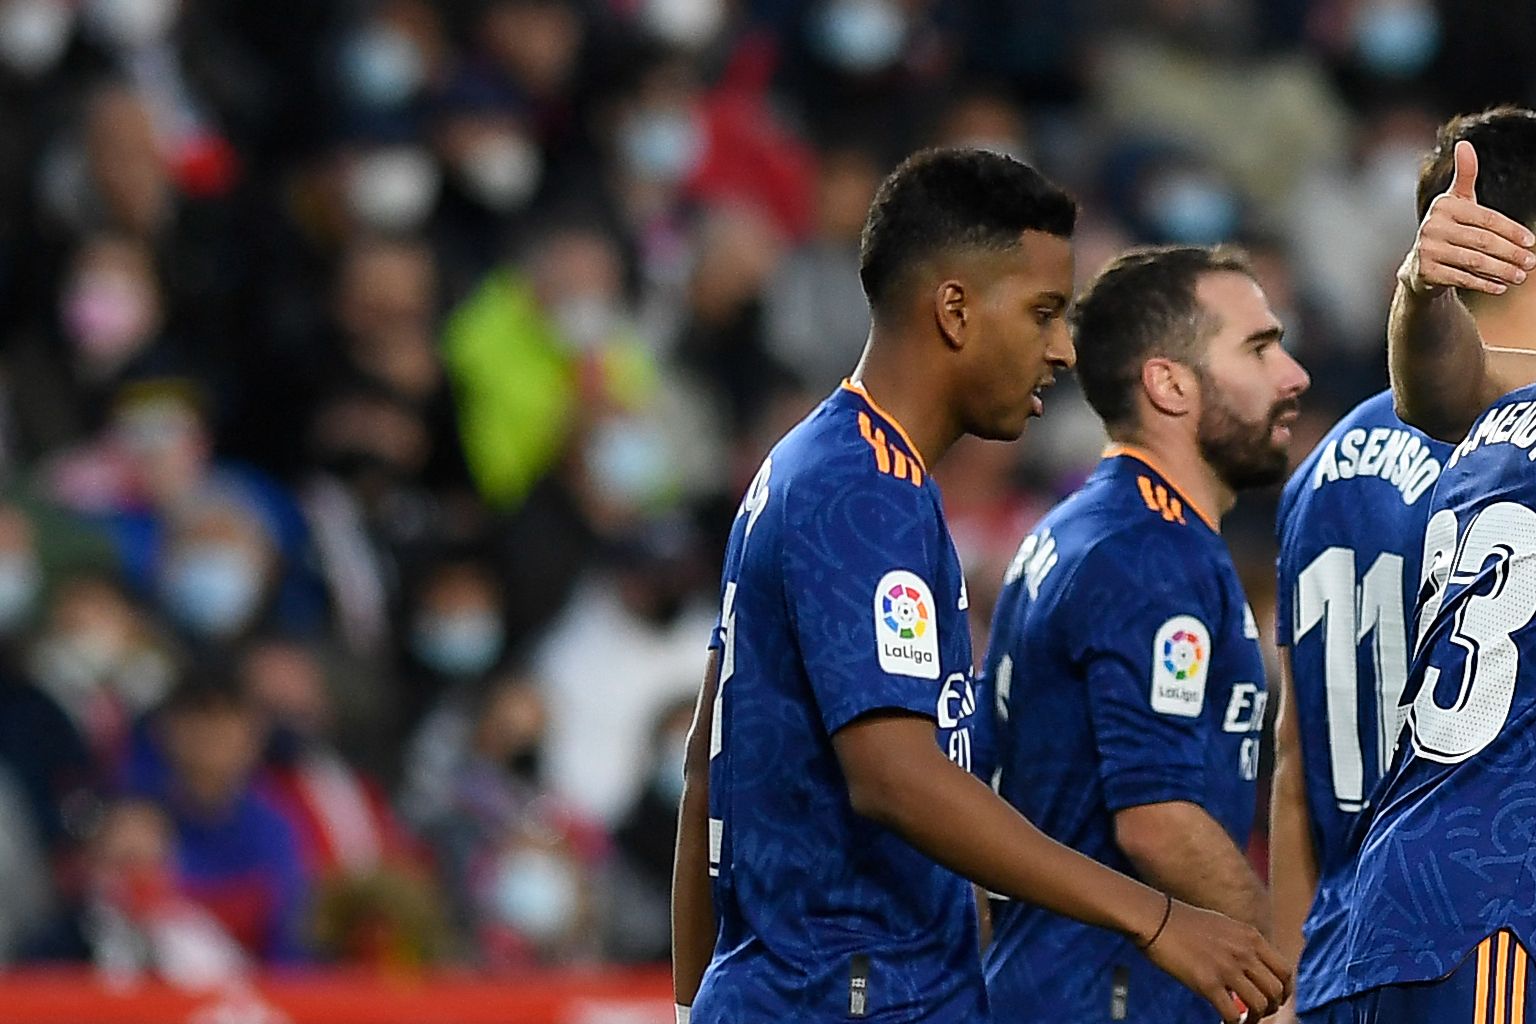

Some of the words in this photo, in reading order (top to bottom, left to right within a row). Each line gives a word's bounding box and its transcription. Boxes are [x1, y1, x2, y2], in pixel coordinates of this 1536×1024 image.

[1313, 427, 1441, 506] ASENSIO
[884, 644, 933, 664] LaLiga
[1293, 546, 1407, 813] 11
